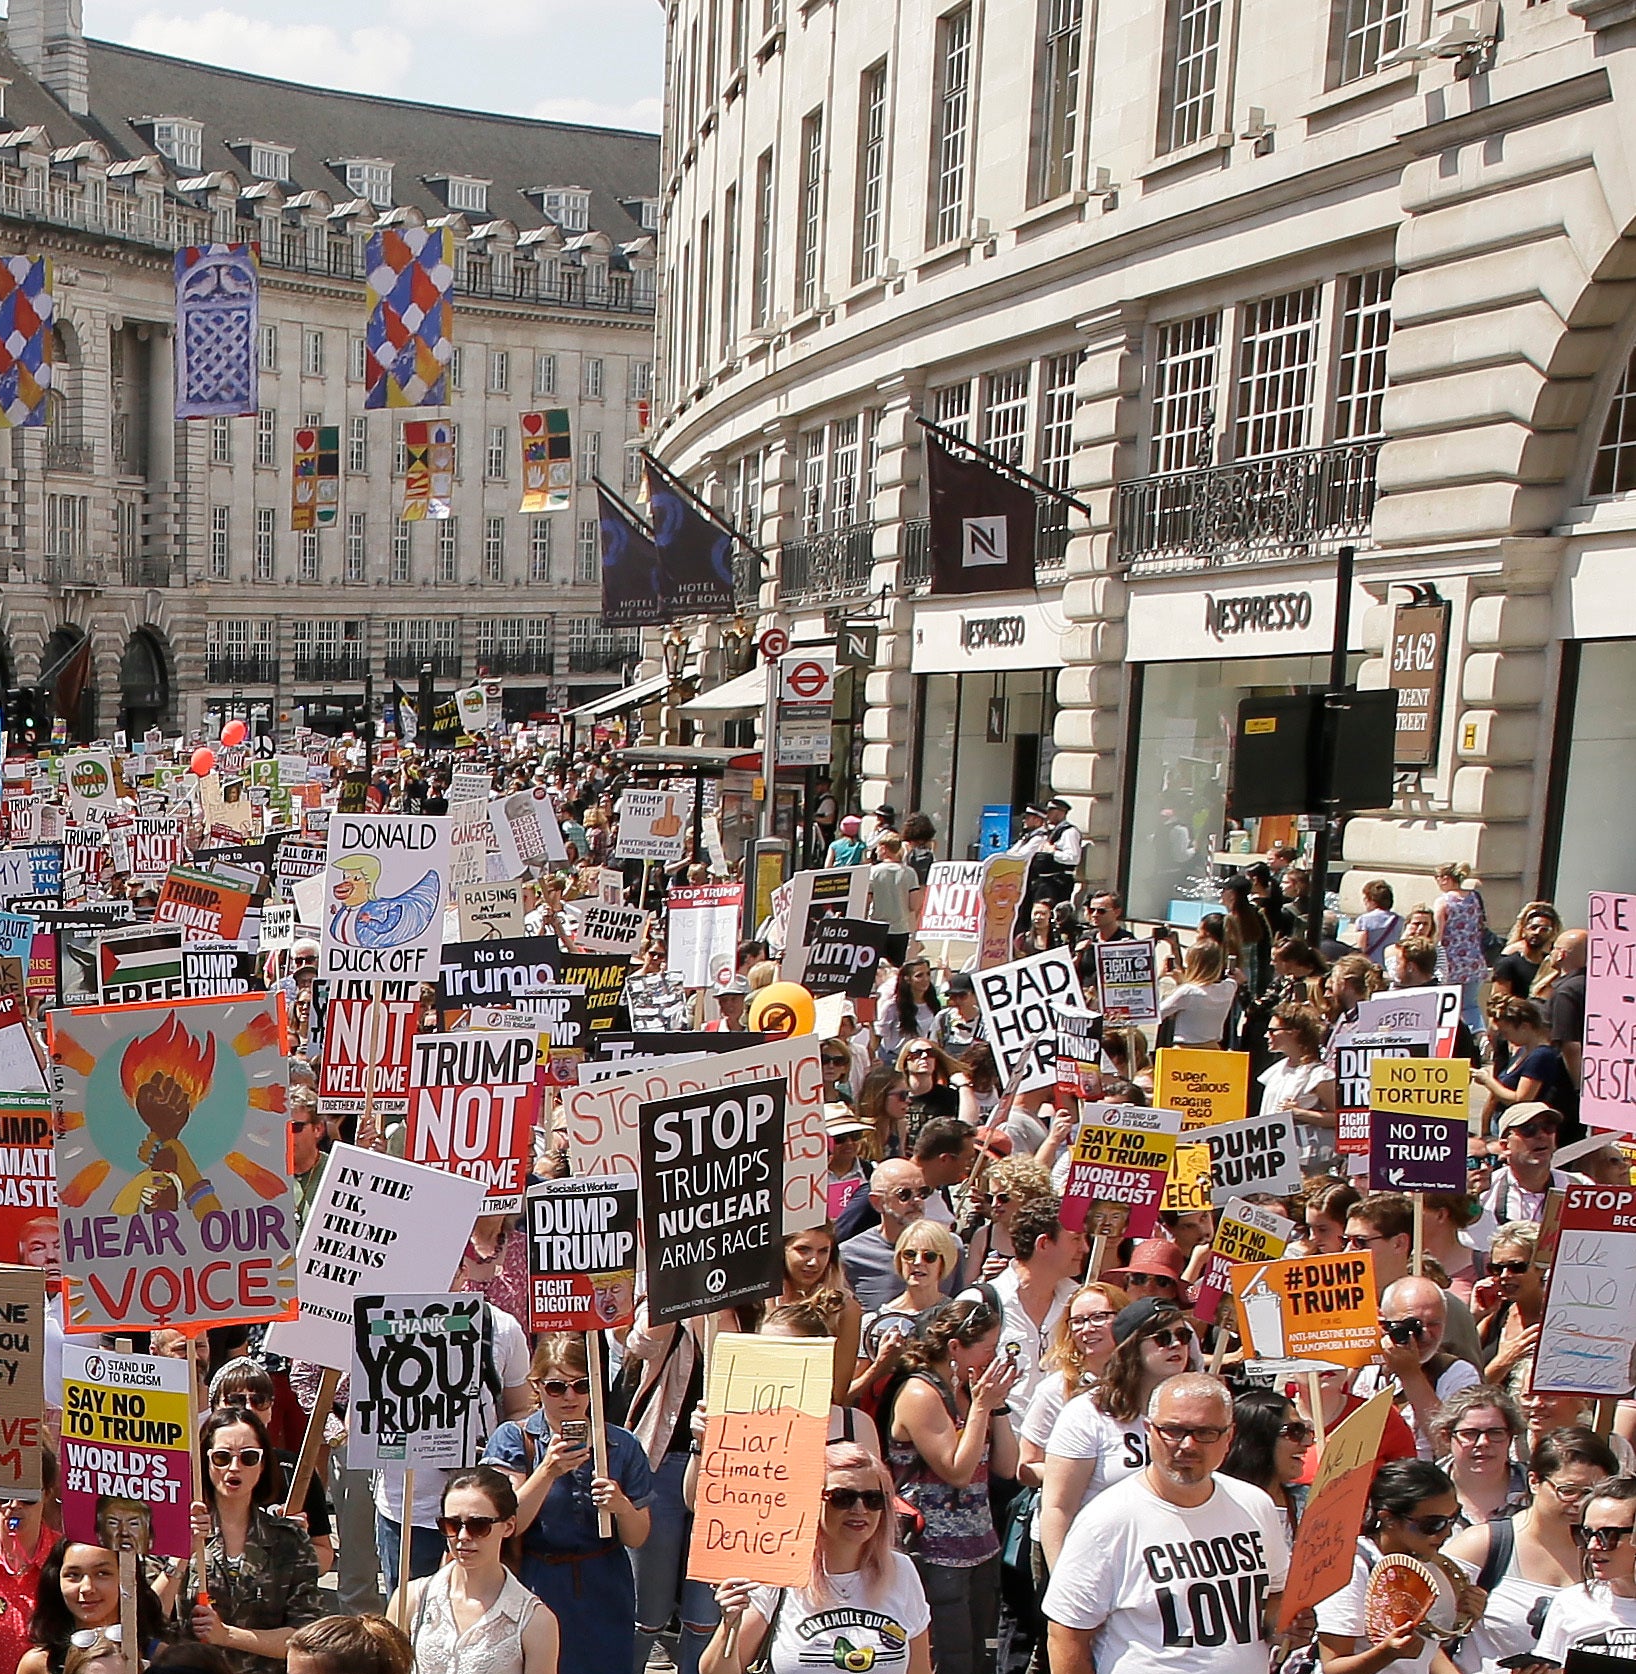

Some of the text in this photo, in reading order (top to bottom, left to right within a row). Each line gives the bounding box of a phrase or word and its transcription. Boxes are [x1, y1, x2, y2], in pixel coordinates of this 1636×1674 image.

[1204, 591, 1312, 643] NESPRESSO
[959, 614, 1026, 655] NESPRESSO
[626, 794, 663, 805] TRUMP
[628, 807, 655, 817] THIS!
[342, 823, 437, 850] DONALD
[584, 906, 644, 928] #DUMP
[583, 923, 638, 944] TRUMP
[329, 948, 428, 972] DUCK OFF
[1391, 1067, 1448, 1083] NO TO
[1375, 1088, 1464, 1104] TORTURE
[1390, 1123, 1448, 1140] NO TO
[1386, 1144, 1451, 1161] TRUMP
[533, 1198, 619, 1235] DUMP
[63, 1204, 291, 1263] HEAR OUR
[532, 1229, 634, 1272] TRUMP
[533, 1277, 574, 1297] FIGHT
[1285, 1261, 1365, 1290] #DUMP
[88, 1257, 278, 1324] VOICE
[533, 1295, 593, 1315] BIGOTRY
[1288, 1287, 1364, 1316] TRUMP
[108, 1360, 155, 1374] STAND UP
[108, 1372, 161, 1386] TO RACISM
[68, 1386, 145, 1418] SAY NO
[725, 1354, 809, 1421] Liar!
[68, 1410, 182, 1445] TO TRUMP
[718, 1418, 793, 1454] Liar!
[705, 1451, 788, 1481] Climate
[705, 1482, 787, 1520] Change
[706, 1512, 805, 1557] Denier!
[1143, 1530, 1266, 1584] CHOOSE
